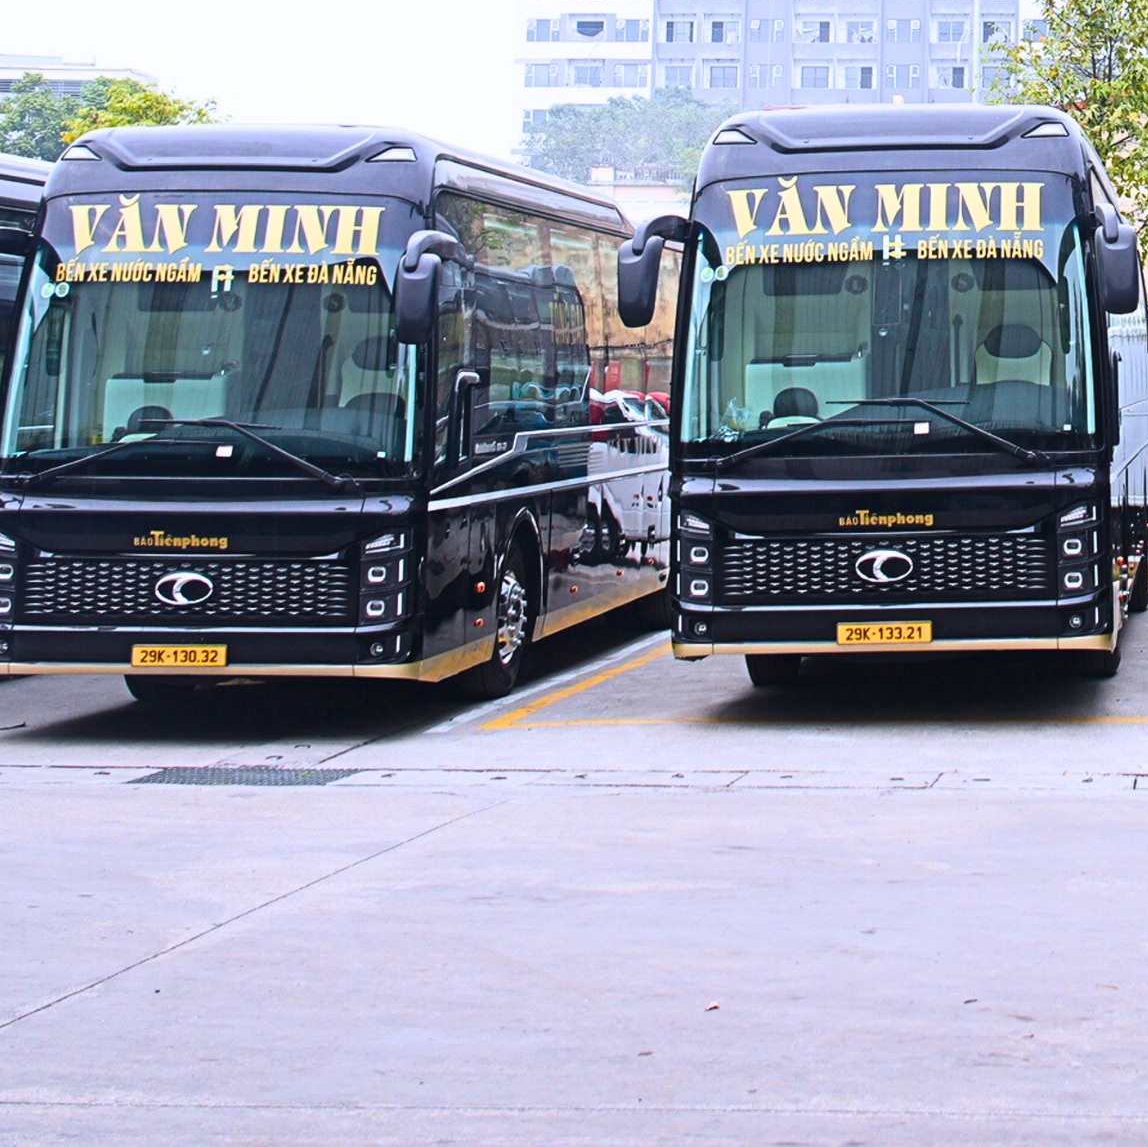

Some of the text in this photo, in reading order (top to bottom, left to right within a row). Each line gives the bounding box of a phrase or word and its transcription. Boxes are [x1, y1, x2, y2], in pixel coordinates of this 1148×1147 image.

[726, 175, 1045, 238] VĂN MINH
[69, 193, 386, 255] VĂN MINH
[726, 240, 755, 265] BẾN
[759, 244, 780, 264] XE
[783, 239, 825, 263] NƯỚC
[918, 234, 948, 259] BẾN
[952, 239, 973, 259] XE
[976, 235, 997, 259] ĐÀ
[56, 257, 86, 283] BẾN
[87, 263, 109, 283] XE
[111, 258, 153, 283] NƯỚC
[248, 258, 280, 284] BẾN
[283, 264, 305, 284] XE
[307, 260, 329, 284] ĐÀ
[845, 626, 922, 641] 29K-133.21
[140, 650, 218, 663] 29K-130.32
